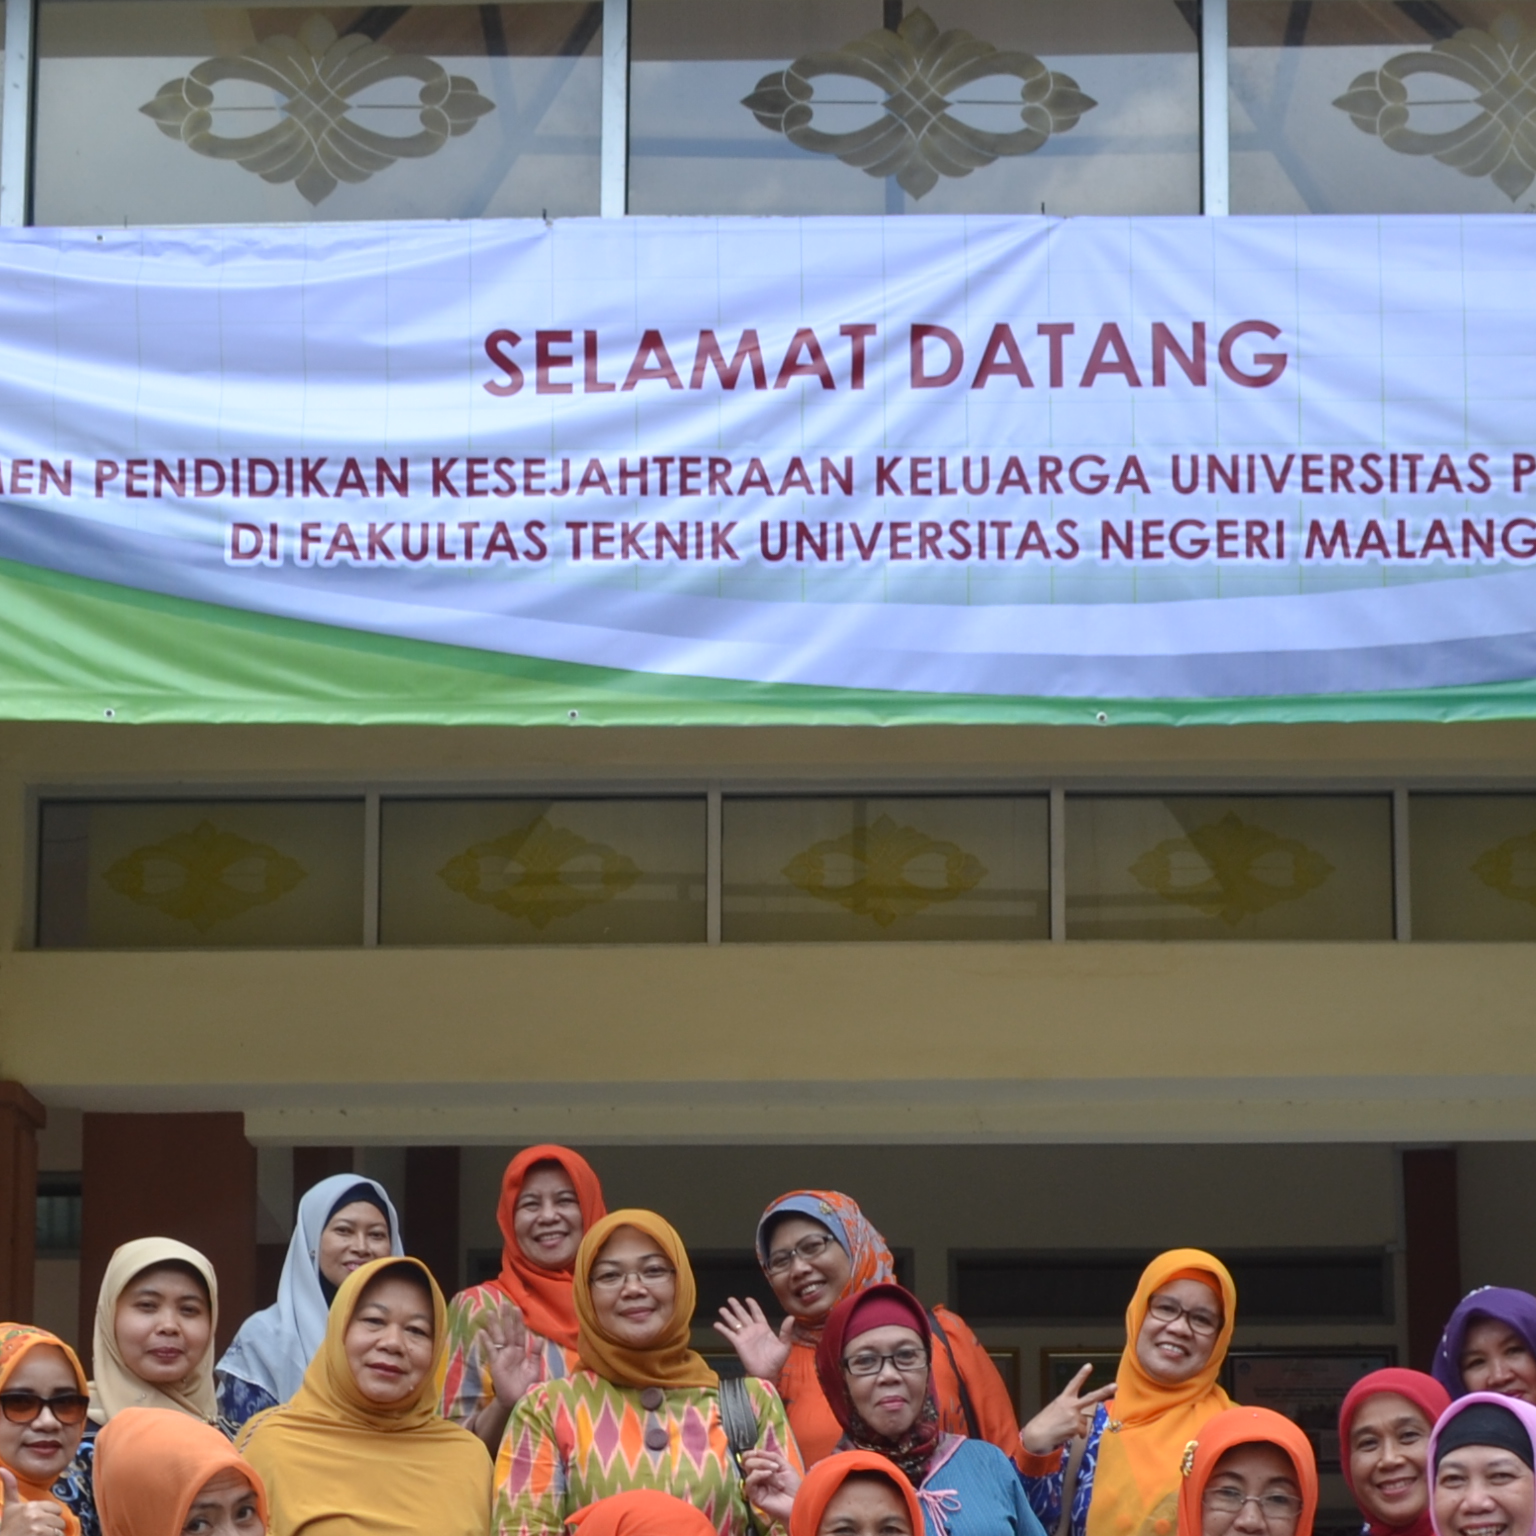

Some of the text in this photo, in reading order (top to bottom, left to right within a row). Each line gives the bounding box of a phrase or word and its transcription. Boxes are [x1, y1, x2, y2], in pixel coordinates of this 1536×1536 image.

[483, 319, 1289, 397] SELAMAT DATANG
[95, 456, 410, 498] PENDIDIKAN
[430, 456, 854, 498] KESEJAHTERAAN
[876, 454, 1150, 495] KELUARGA
[1171, 452, 1492, 496] UNIVERSITAS
[230, 522, 279, 561] DI
[301, 520, 548, 562] FAKULTAS
[566, 519, 739, 562] TEKNIK
[761, 519, 1080, 562] UNIVERSITAS
[1101, 518, 1285, 561] NEGERI
